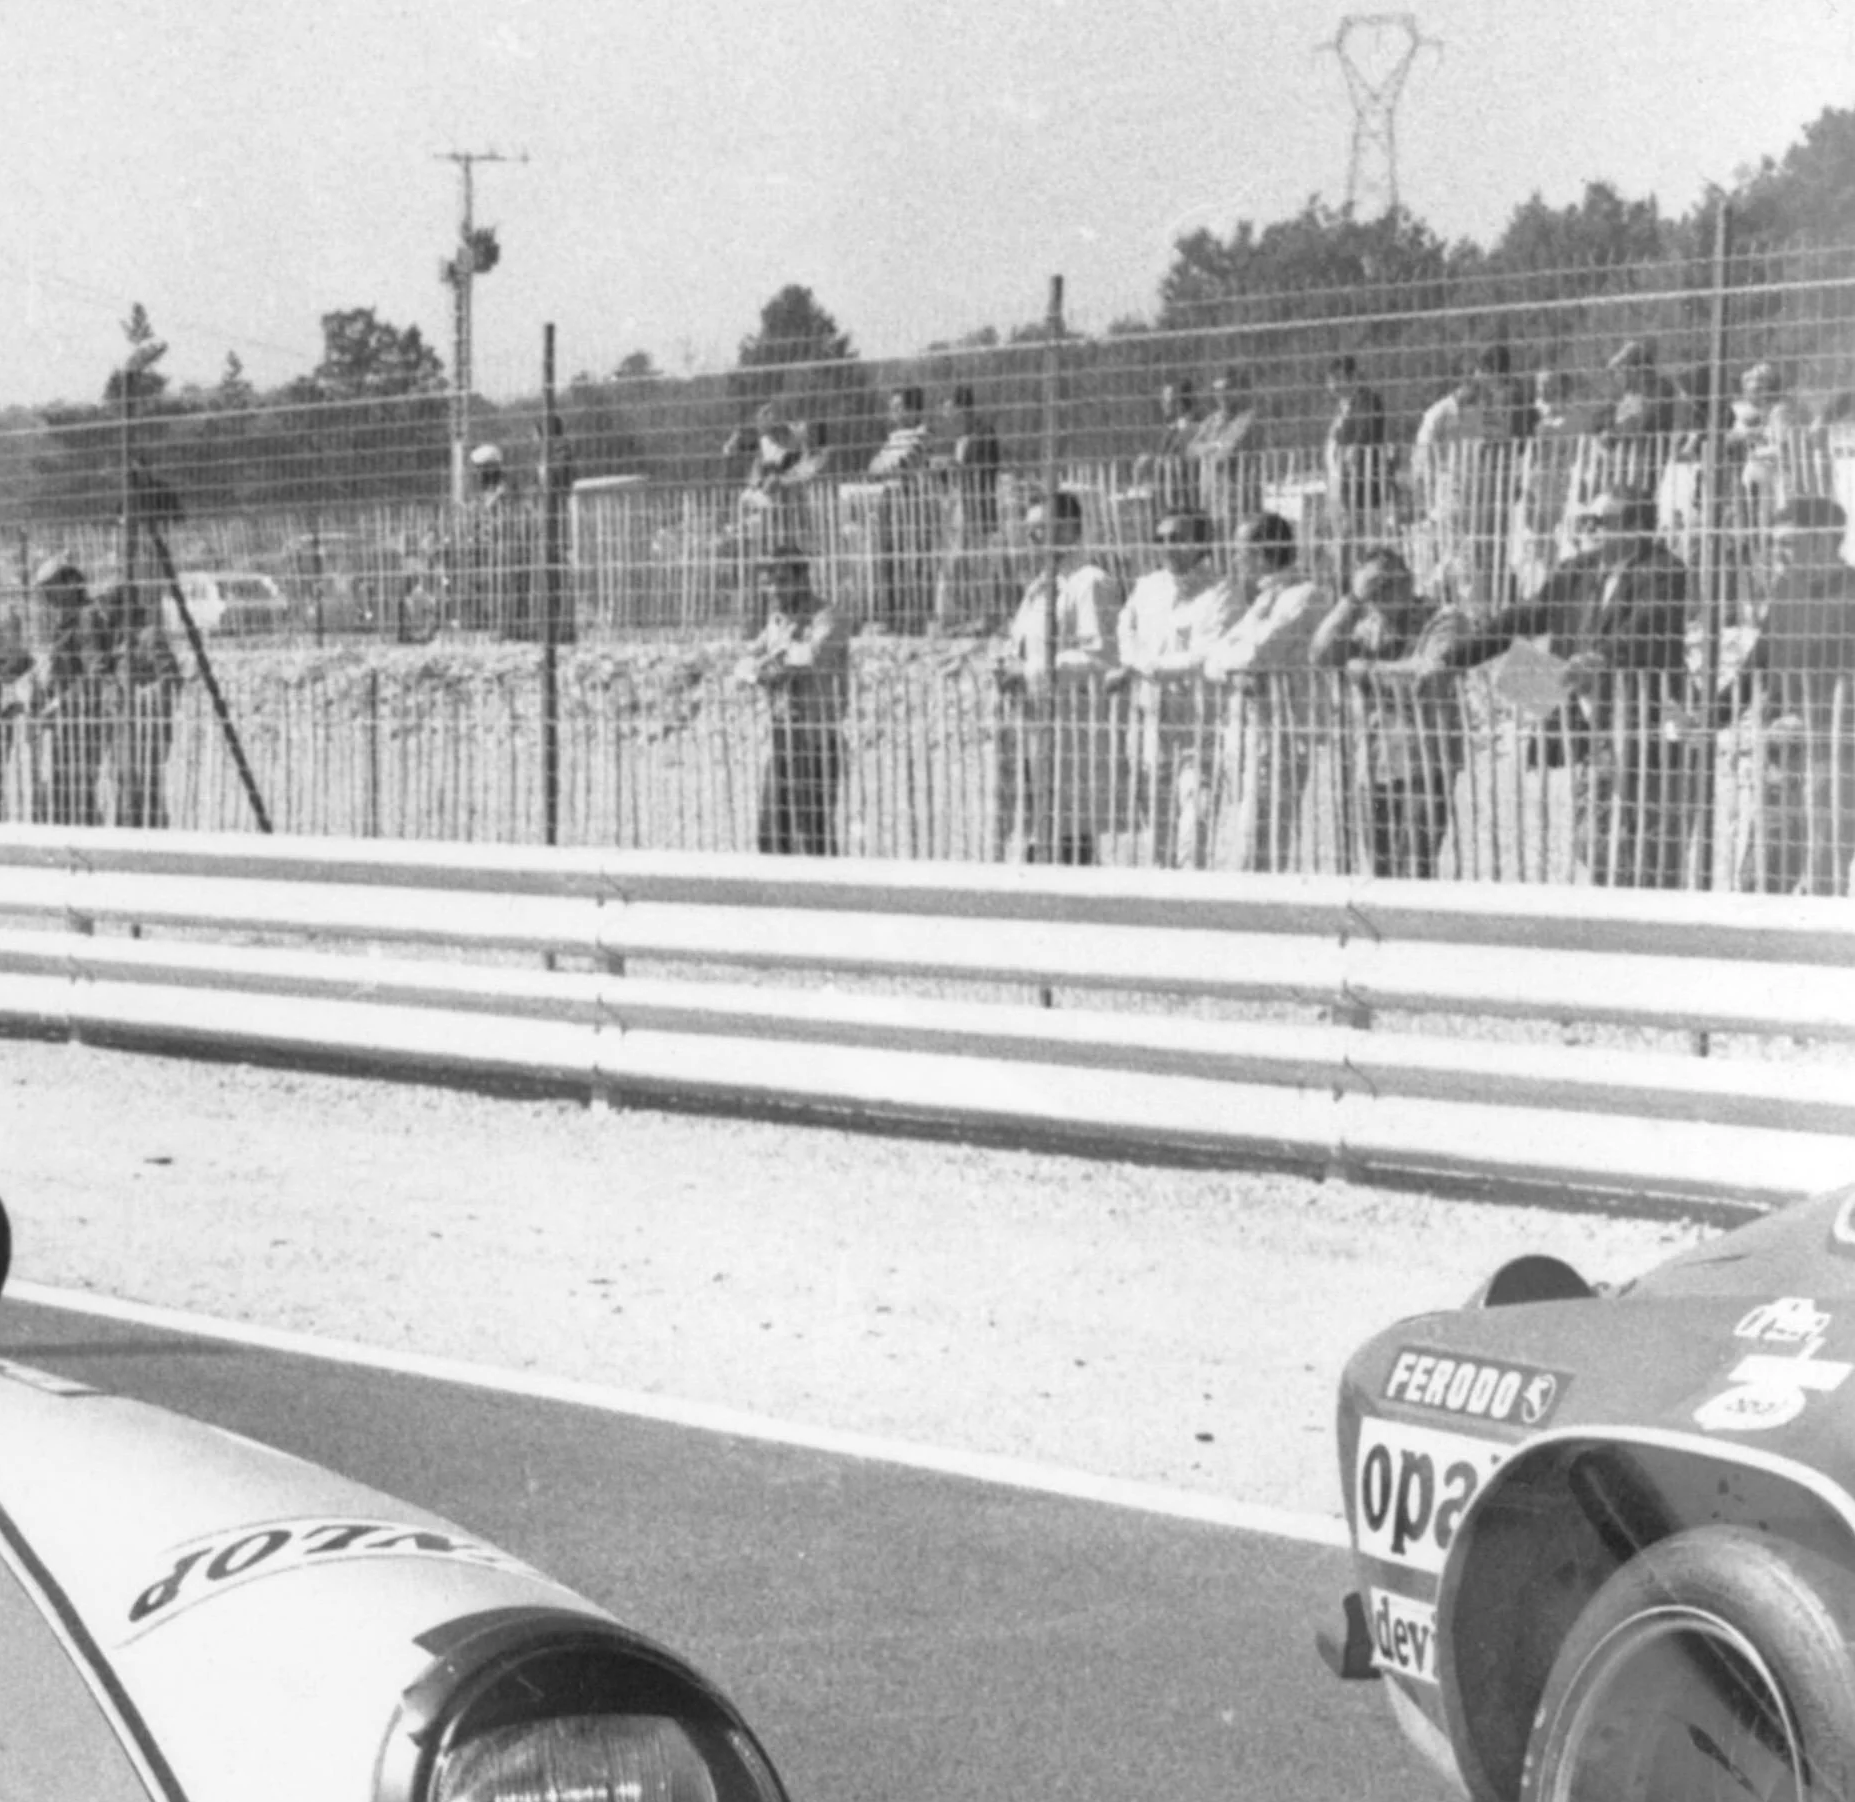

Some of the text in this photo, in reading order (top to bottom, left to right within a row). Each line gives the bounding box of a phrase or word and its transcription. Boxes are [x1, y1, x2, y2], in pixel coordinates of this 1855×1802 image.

[1386, 1351, 1524, 1419] FERODO
[1362, 1442, 1500, 1556] opa
[129, 1523, 496, 1622] NLOP
[1376, 1596, 1437, 1675] dev
